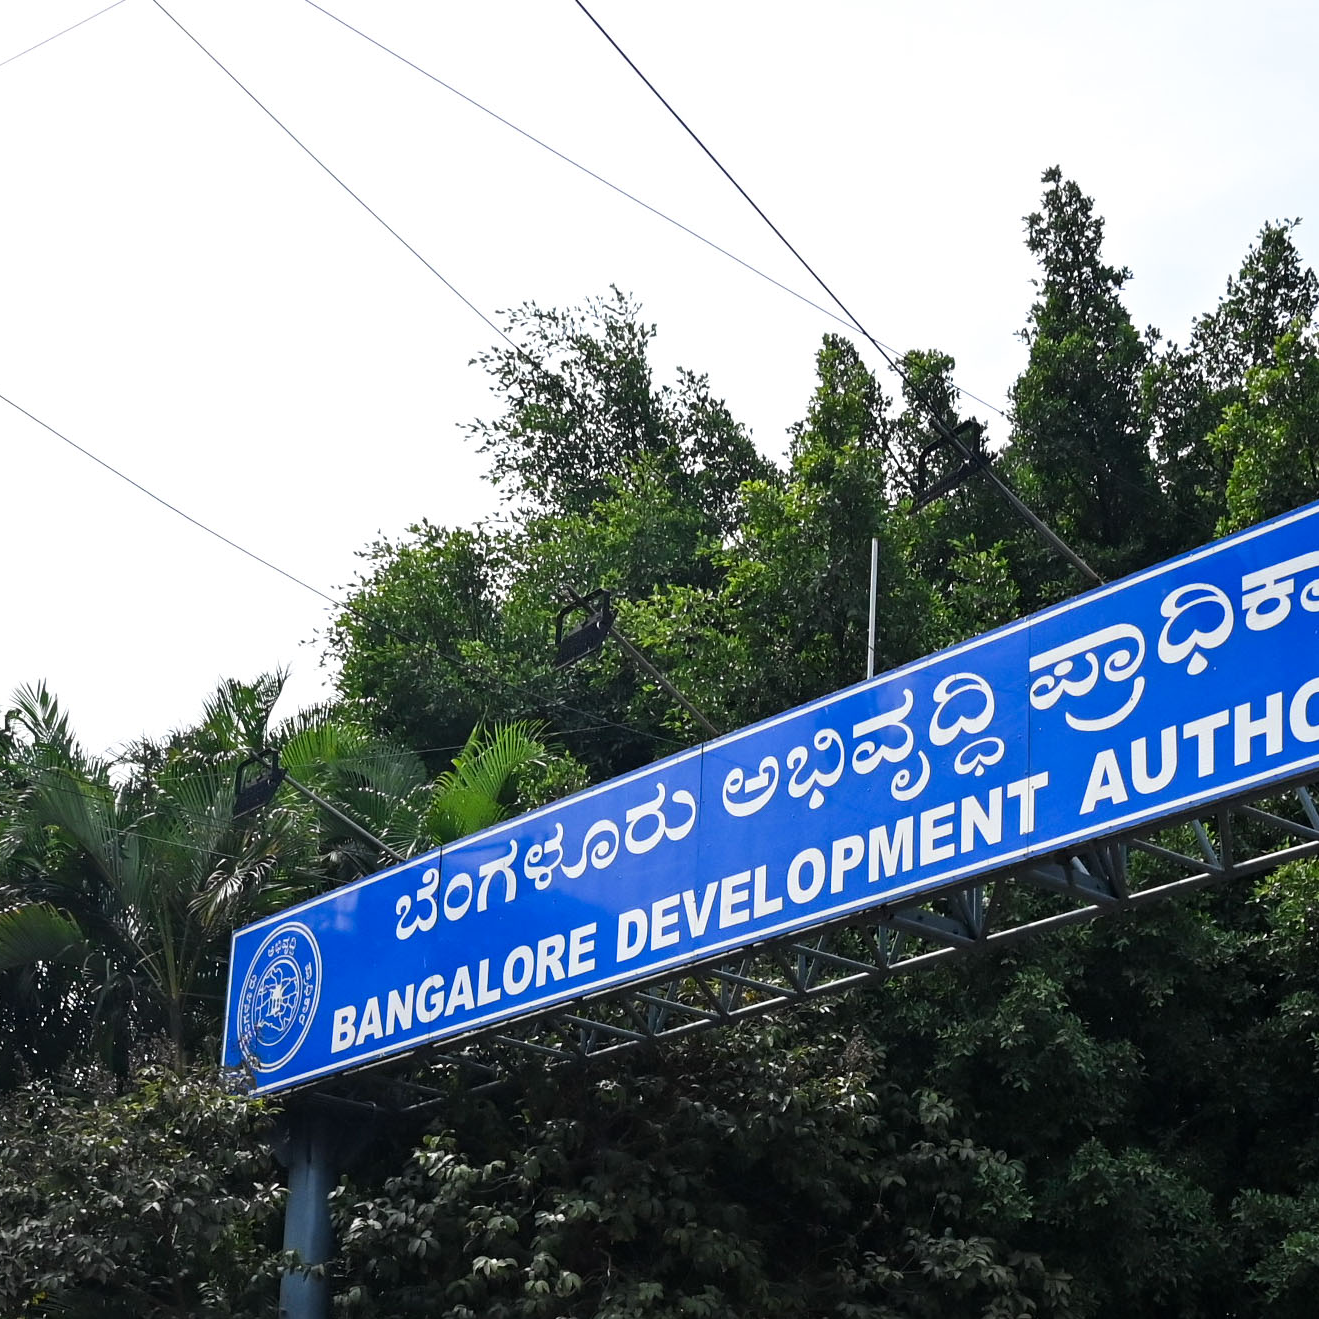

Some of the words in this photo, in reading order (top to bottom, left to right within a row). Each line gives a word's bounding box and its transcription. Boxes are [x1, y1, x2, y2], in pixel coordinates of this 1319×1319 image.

[330, 922, 599, 1054] BANGALORE
[615, 771, 1051, 964] DEVELOPMENT
[394, 782, 698, 941] ಬೆಂಗಳೂರು
[722, 671, 1006, 817] ಅಭಿವೃದ್ಧಿ
